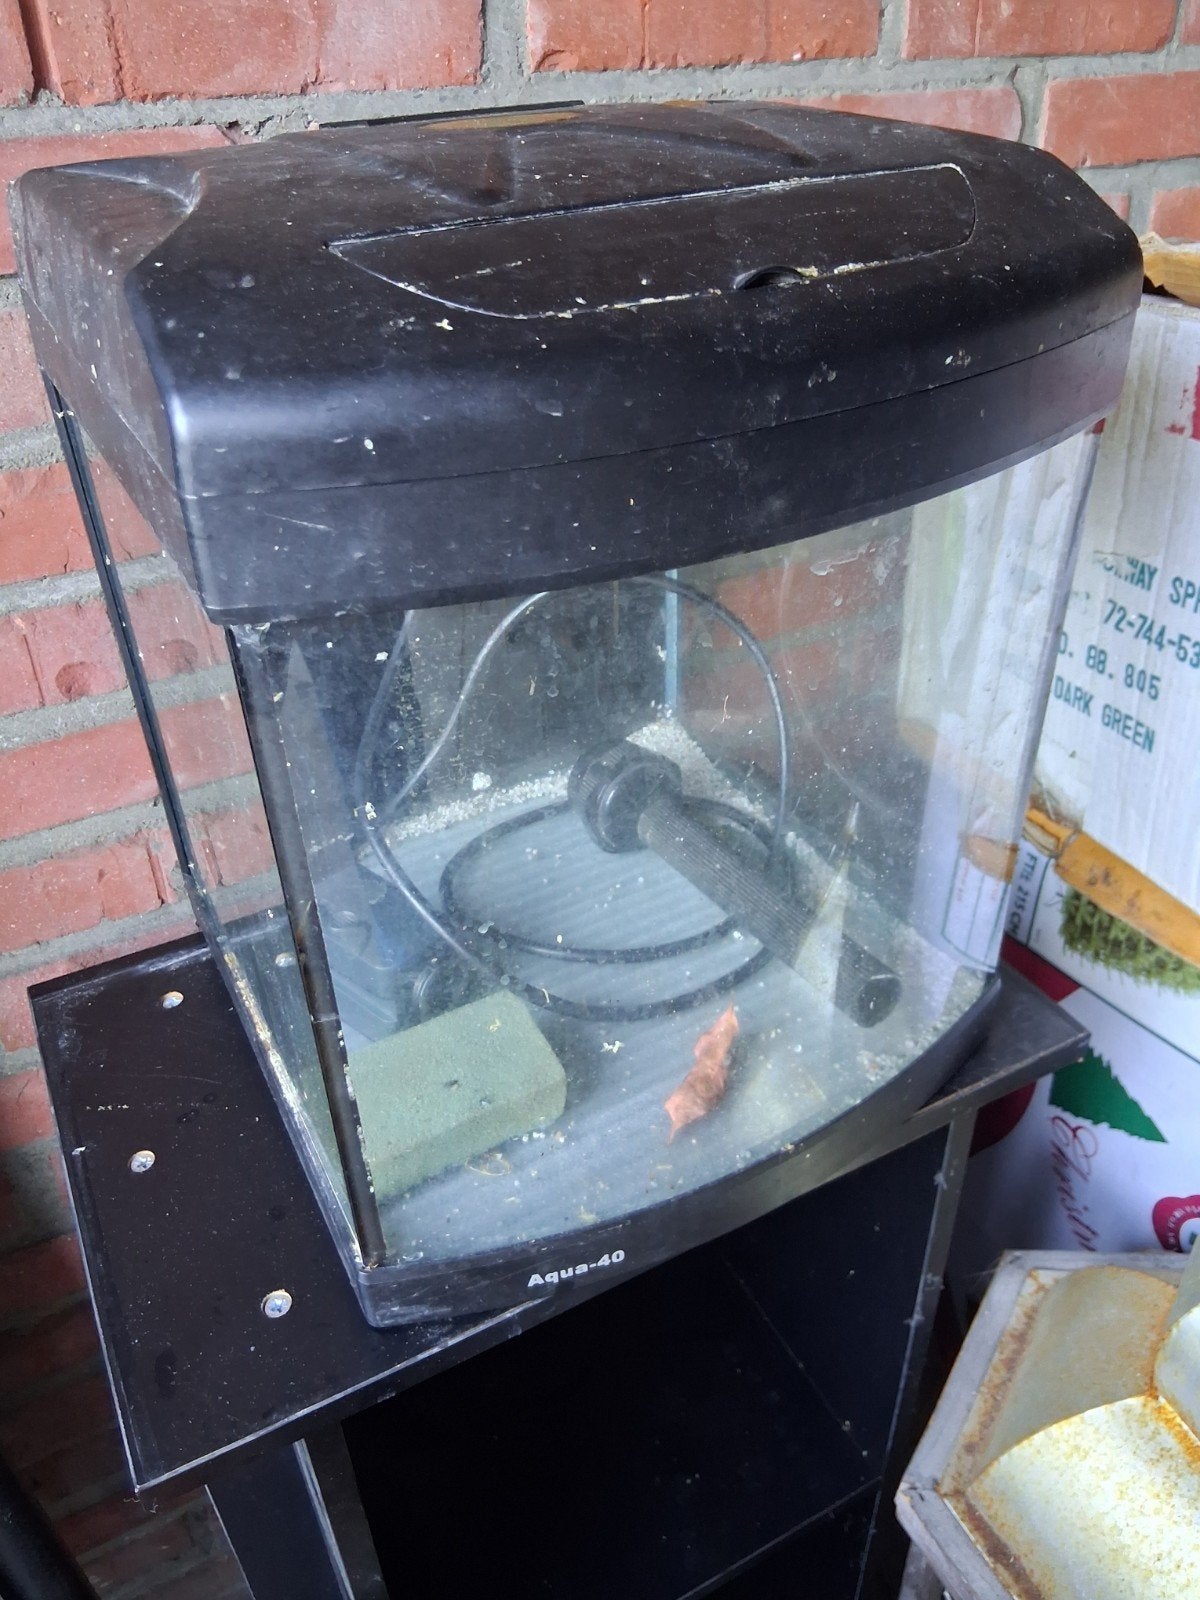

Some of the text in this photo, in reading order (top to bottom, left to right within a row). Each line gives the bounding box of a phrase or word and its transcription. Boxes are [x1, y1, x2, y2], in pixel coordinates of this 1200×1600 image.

[1054, 675, 1155, 753] DARK GREEN
[527, 1249, 625, 1287] Aqua-40
